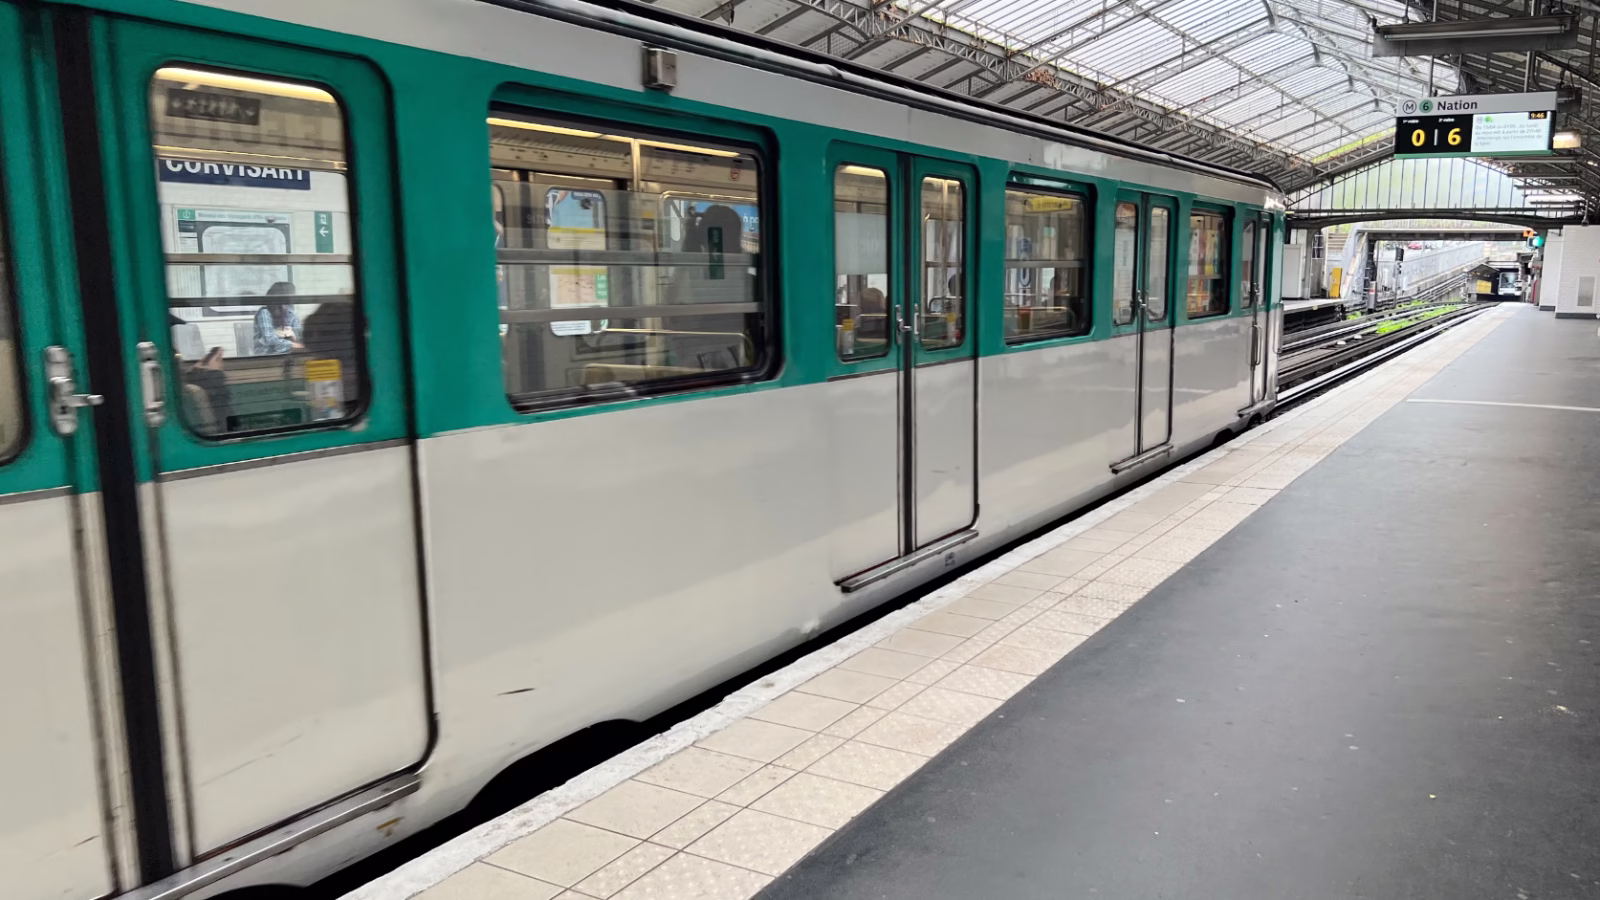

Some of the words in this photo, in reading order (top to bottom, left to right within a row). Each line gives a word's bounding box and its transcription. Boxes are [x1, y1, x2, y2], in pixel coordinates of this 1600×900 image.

[1422, 102, 1430, 111] 6
[1437, 100, 1478, 111] Nation
[1411, 128, 1425, 147] 0
[1447, 127, 1462, 146] 6
[165, 159, 303, 181] CORVISART
